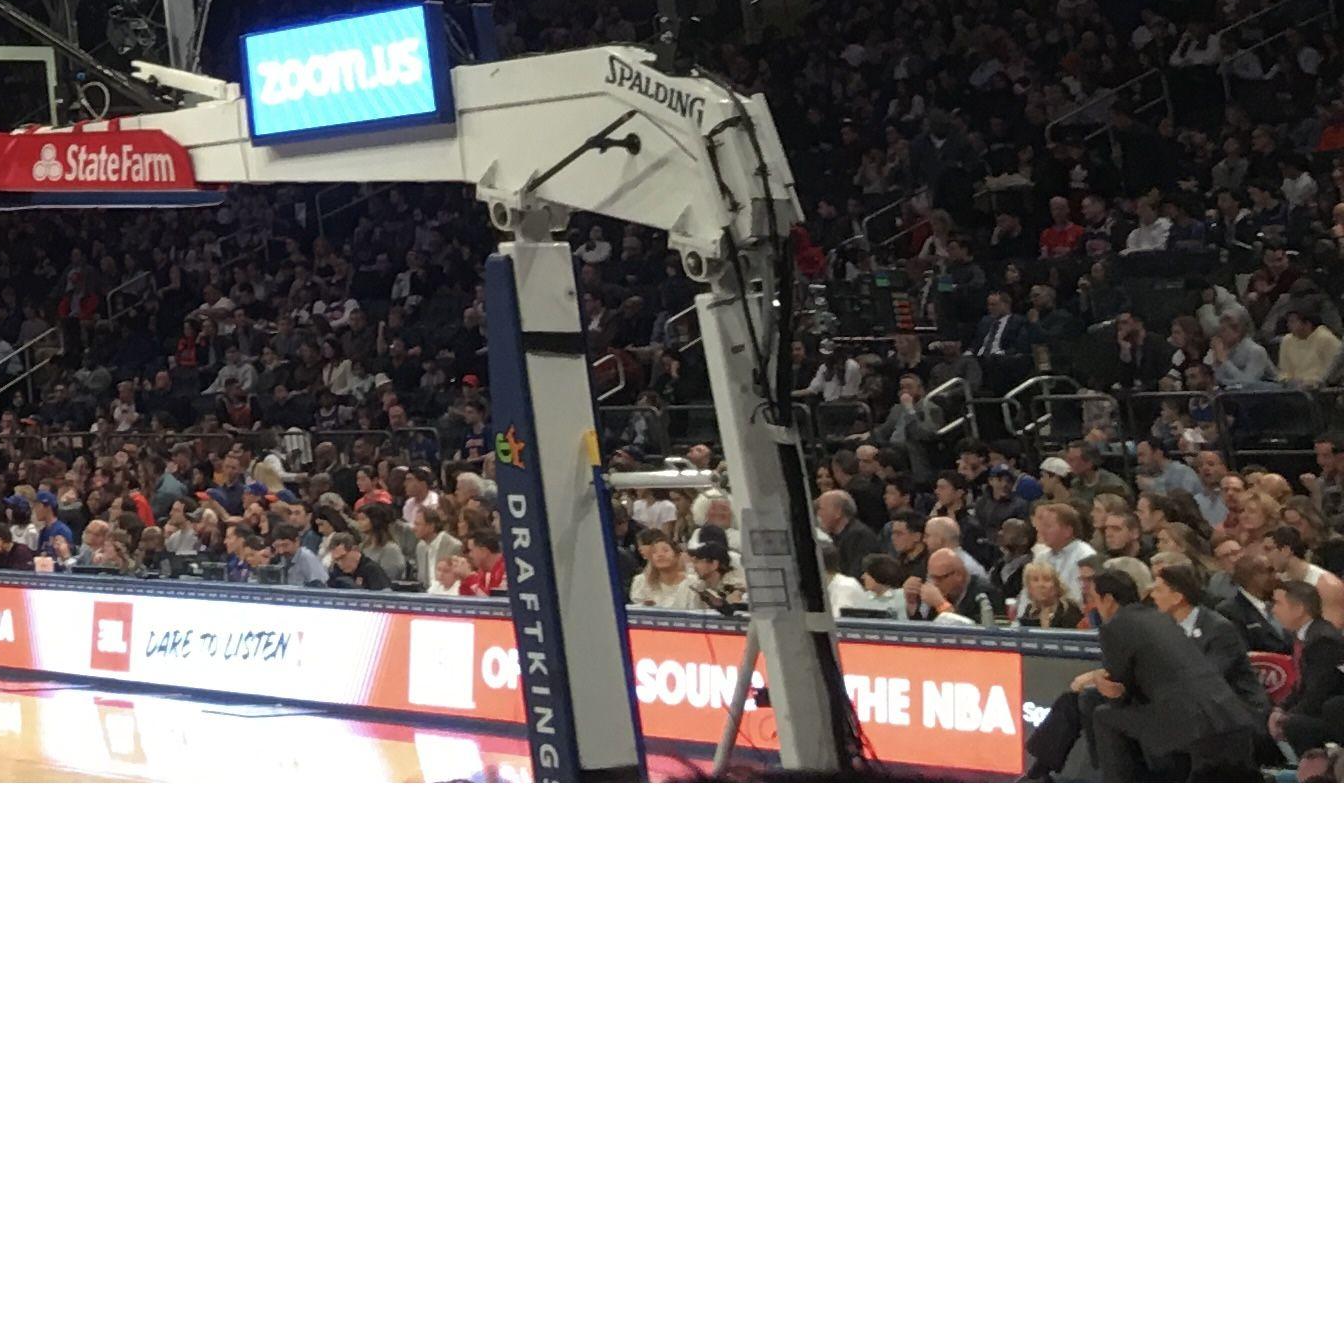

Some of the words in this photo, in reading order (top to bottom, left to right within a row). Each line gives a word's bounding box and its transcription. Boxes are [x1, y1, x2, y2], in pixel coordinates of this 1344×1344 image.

[605, 54, 705, 128] SPALDING
[146, 630, 193, 658] DARE
[224, 630, 291, 661] LISTEN
[507, 494, 561, 782] DRAFTKING
[843, 674, 911, 726] THE
[922, 679, 1017, 735] NBA
